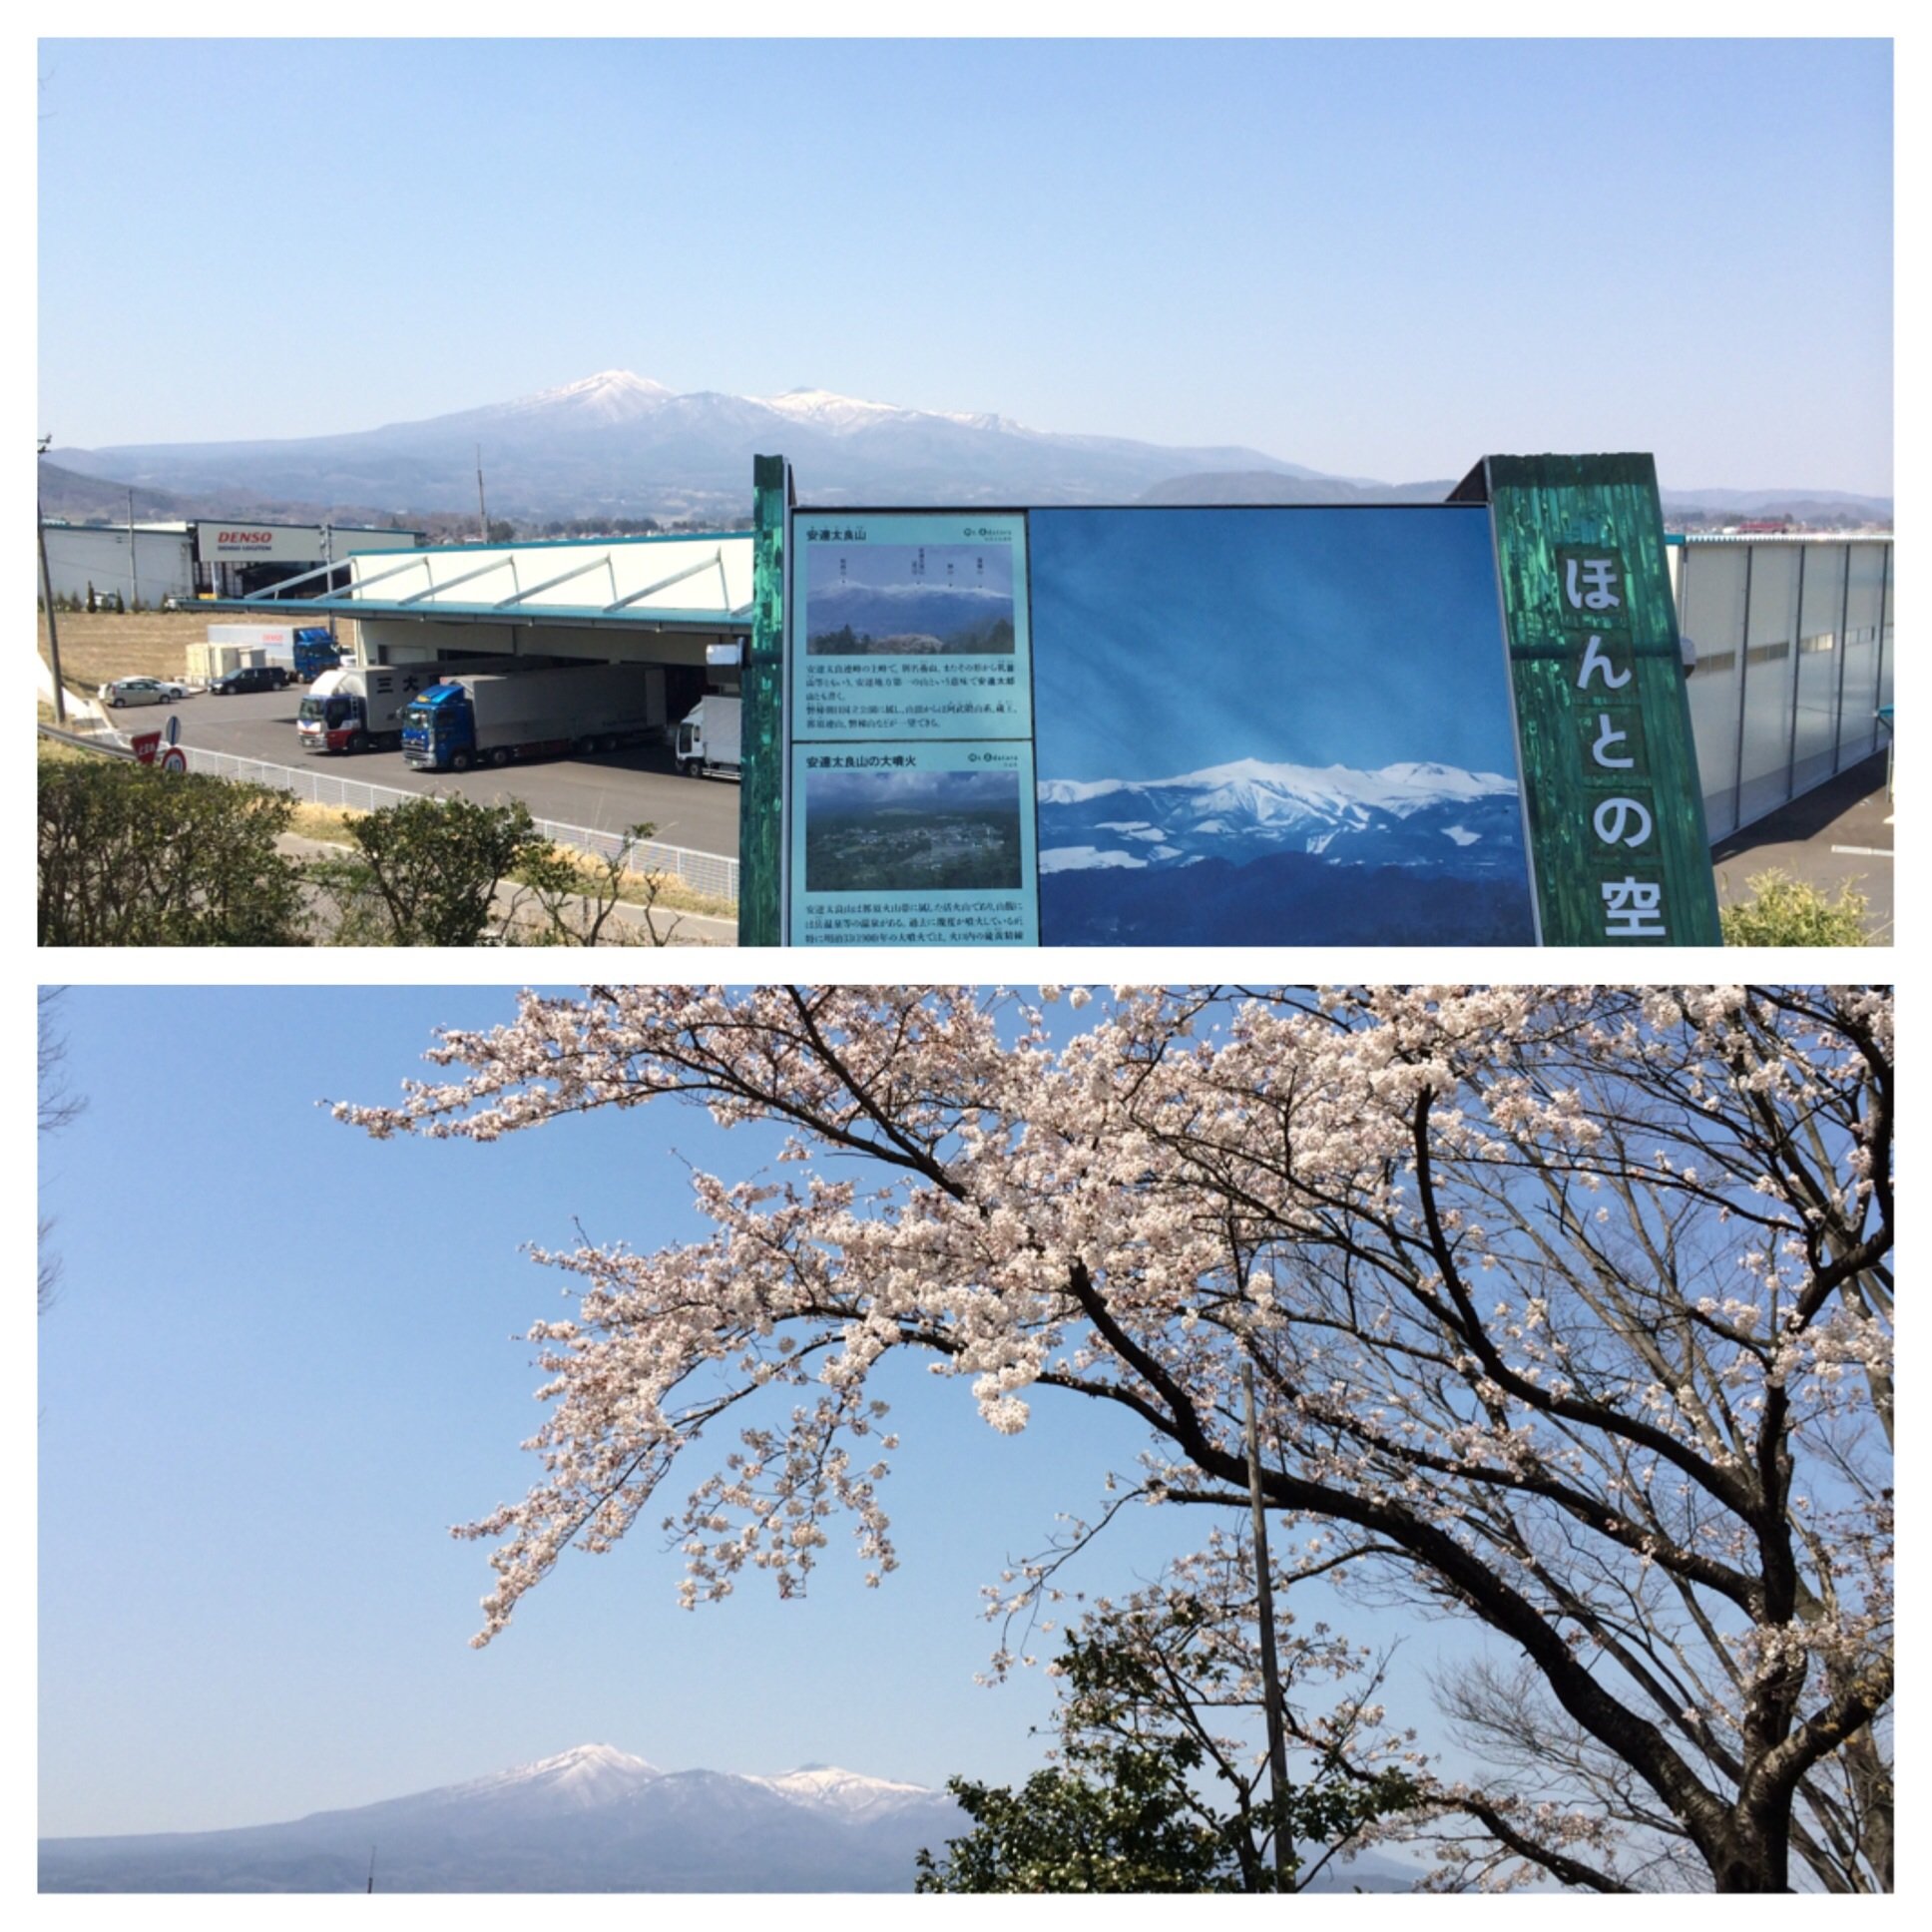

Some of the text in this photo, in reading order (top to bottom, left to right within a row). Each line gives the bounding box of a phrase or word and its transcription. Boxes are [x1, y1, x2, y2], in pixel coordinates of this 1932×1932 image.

[218, 531, 272, 543] DENSO
[806, 529, 867, 542] 安達太良山
[1565, 558, 1667, 937] ほんとの空
[806, 755, 917, 768] 安達太良山の大噴火
